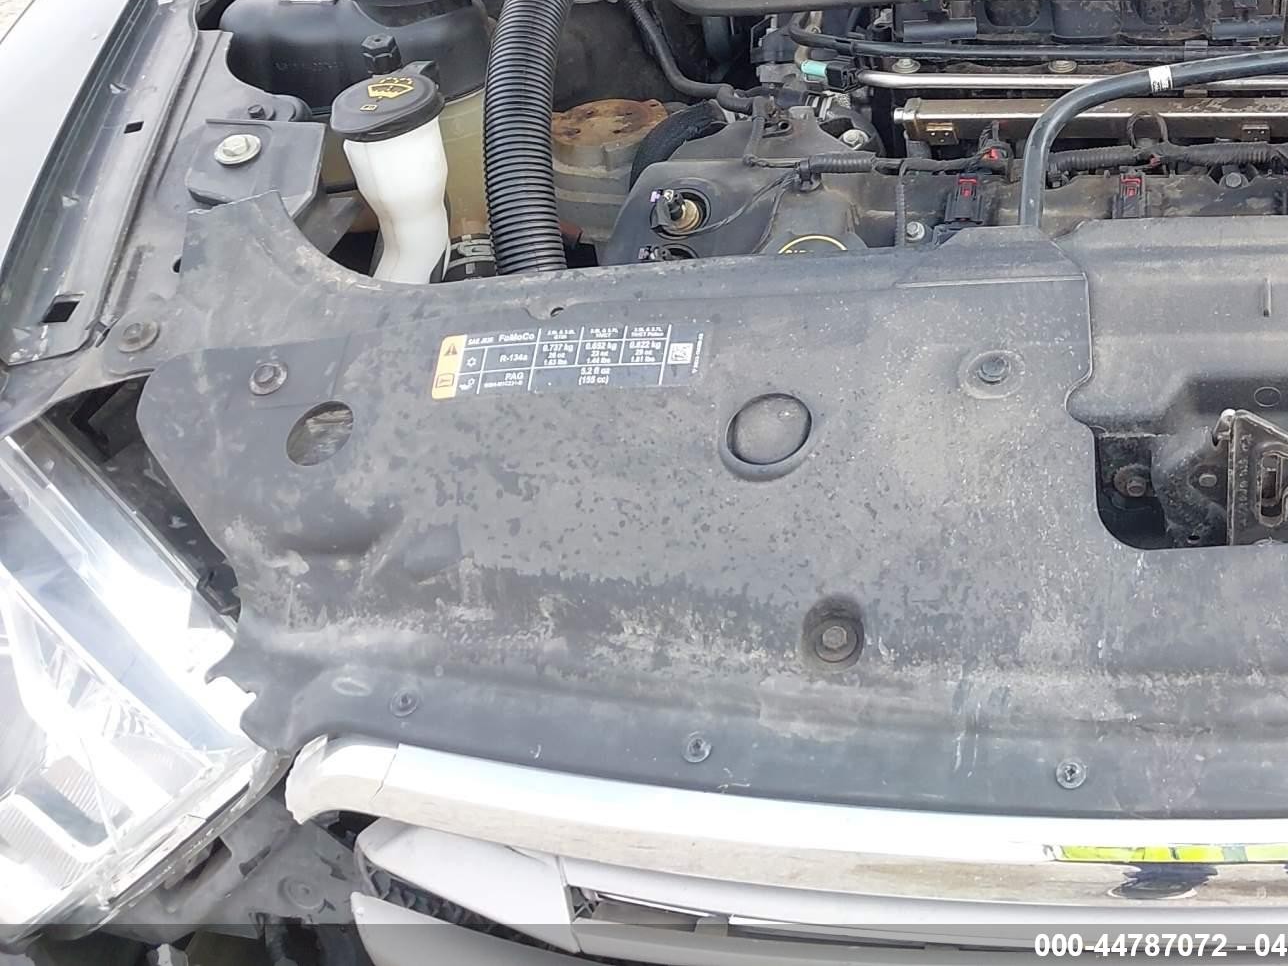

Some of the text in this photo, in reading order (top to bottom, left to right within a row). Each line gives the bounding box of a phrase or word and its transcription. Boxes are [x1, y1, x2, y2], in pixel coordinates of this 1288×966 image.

[498, 332, 535, 342] FoMoCo
[564, 344, 574, 352] kg
[606, 342, 618, 351] kg
[651, 340, 662, 350] kg
[500, 354, 528, 362] R-134a
[580, 367, 592, 375] 5.2
[504, 372, 524, 381] PAG
